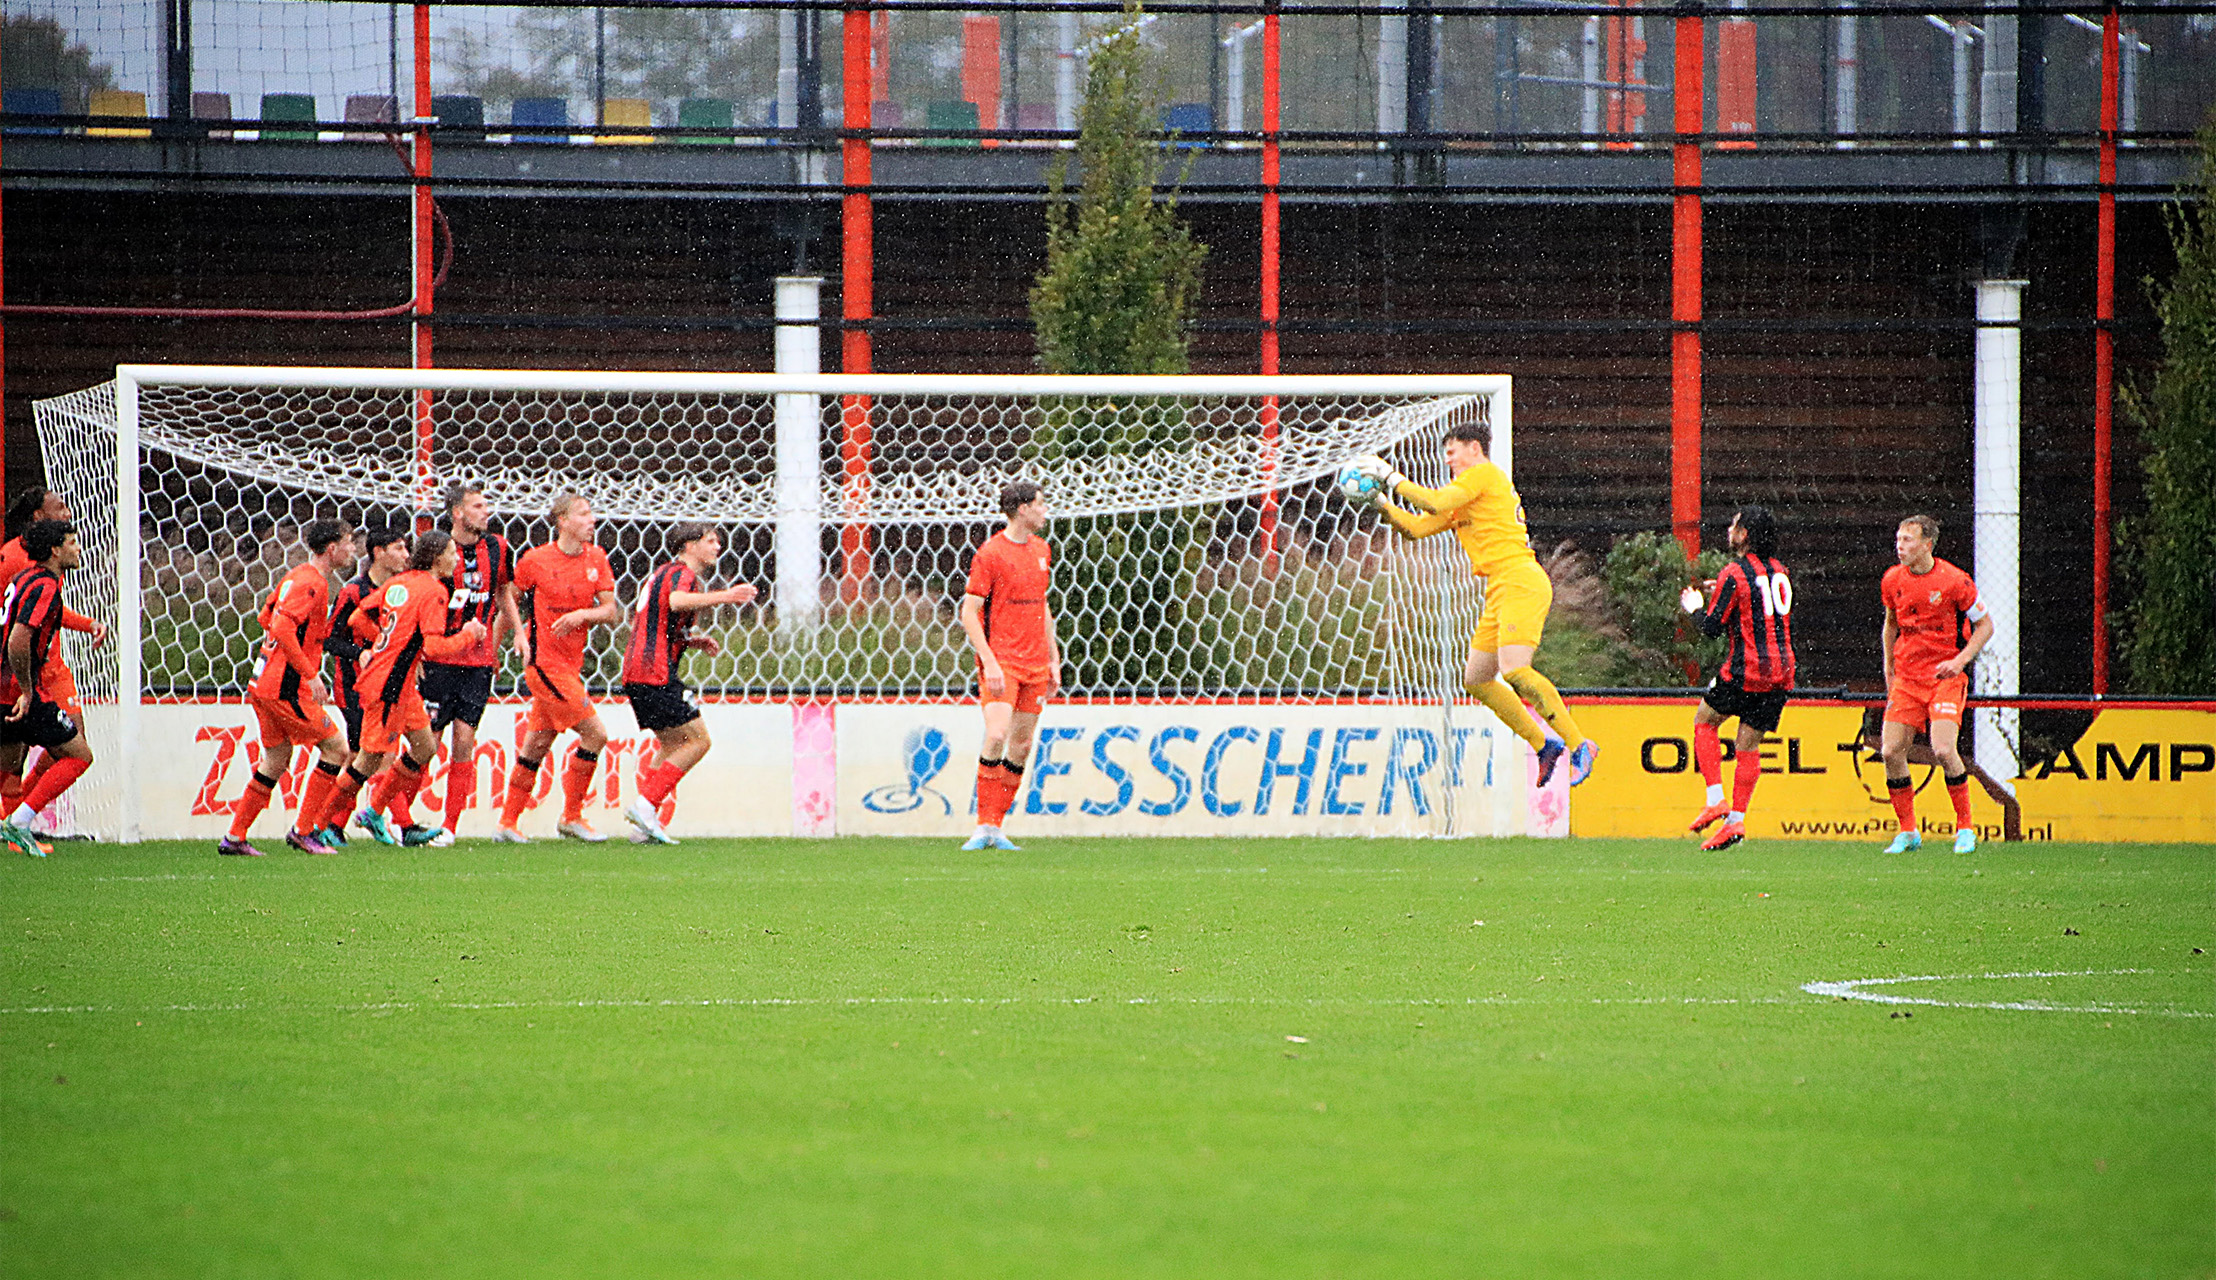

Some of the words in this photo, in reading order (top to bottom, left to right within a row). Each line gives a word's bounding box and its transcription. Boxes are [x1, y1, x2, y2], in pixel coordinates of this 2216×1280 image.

[1755, 572, 1792, 616] 10
[969, 726, 1432, 817] ESSCHER
[2016, 743, 2216, 782] AMP
